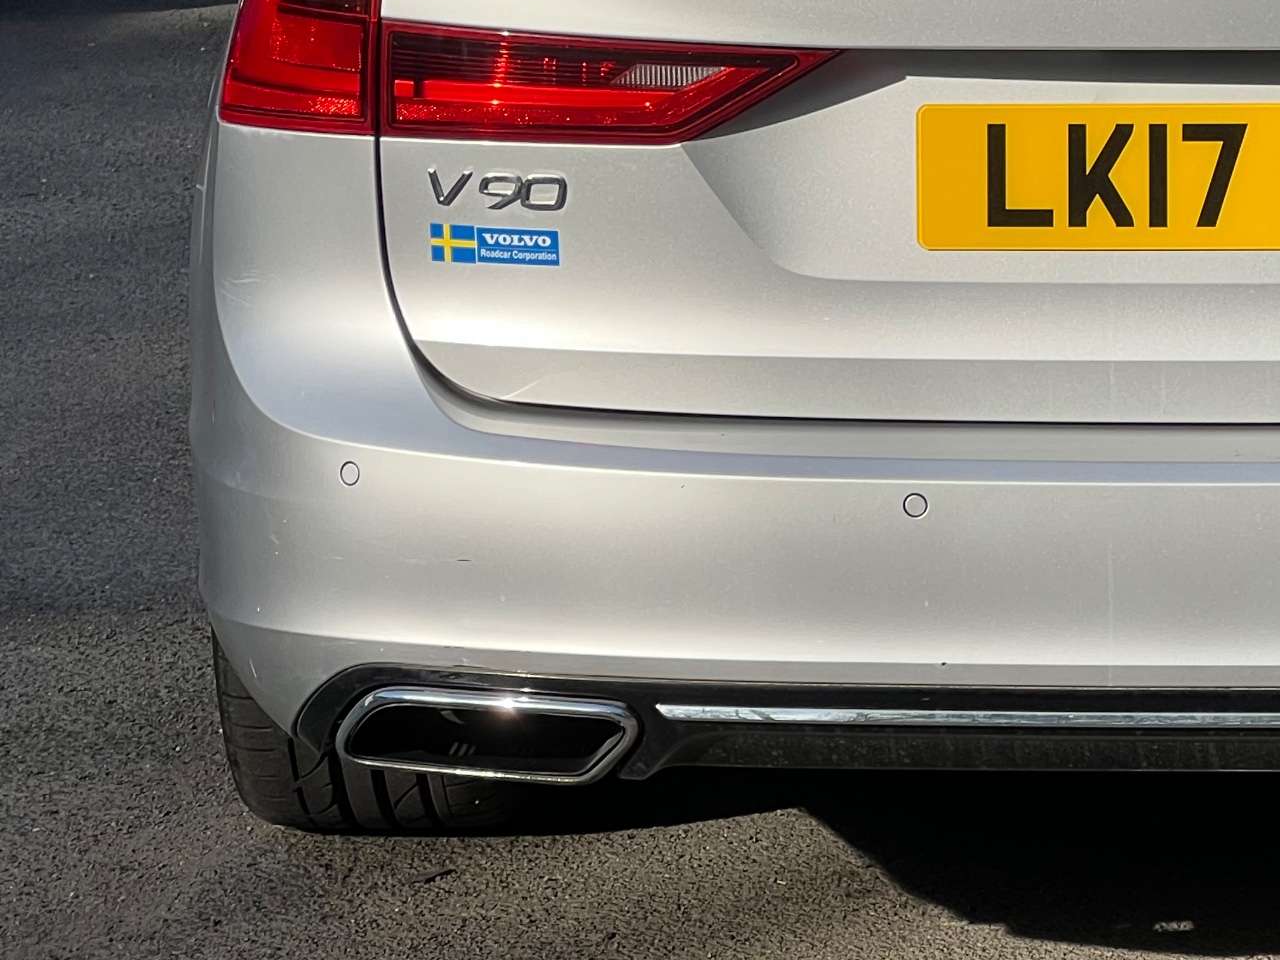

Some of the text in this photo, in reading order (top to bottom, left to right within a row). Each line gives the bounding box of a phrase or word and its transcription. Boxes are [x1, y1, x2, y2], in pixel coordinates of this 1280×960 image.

[427, 168, 568, 212] V90
[986, 123, 1249, 228] LK17
[482, 233, 552, 247] VOLVO
[480, 248, 558, 262] Roadcar Corporation
